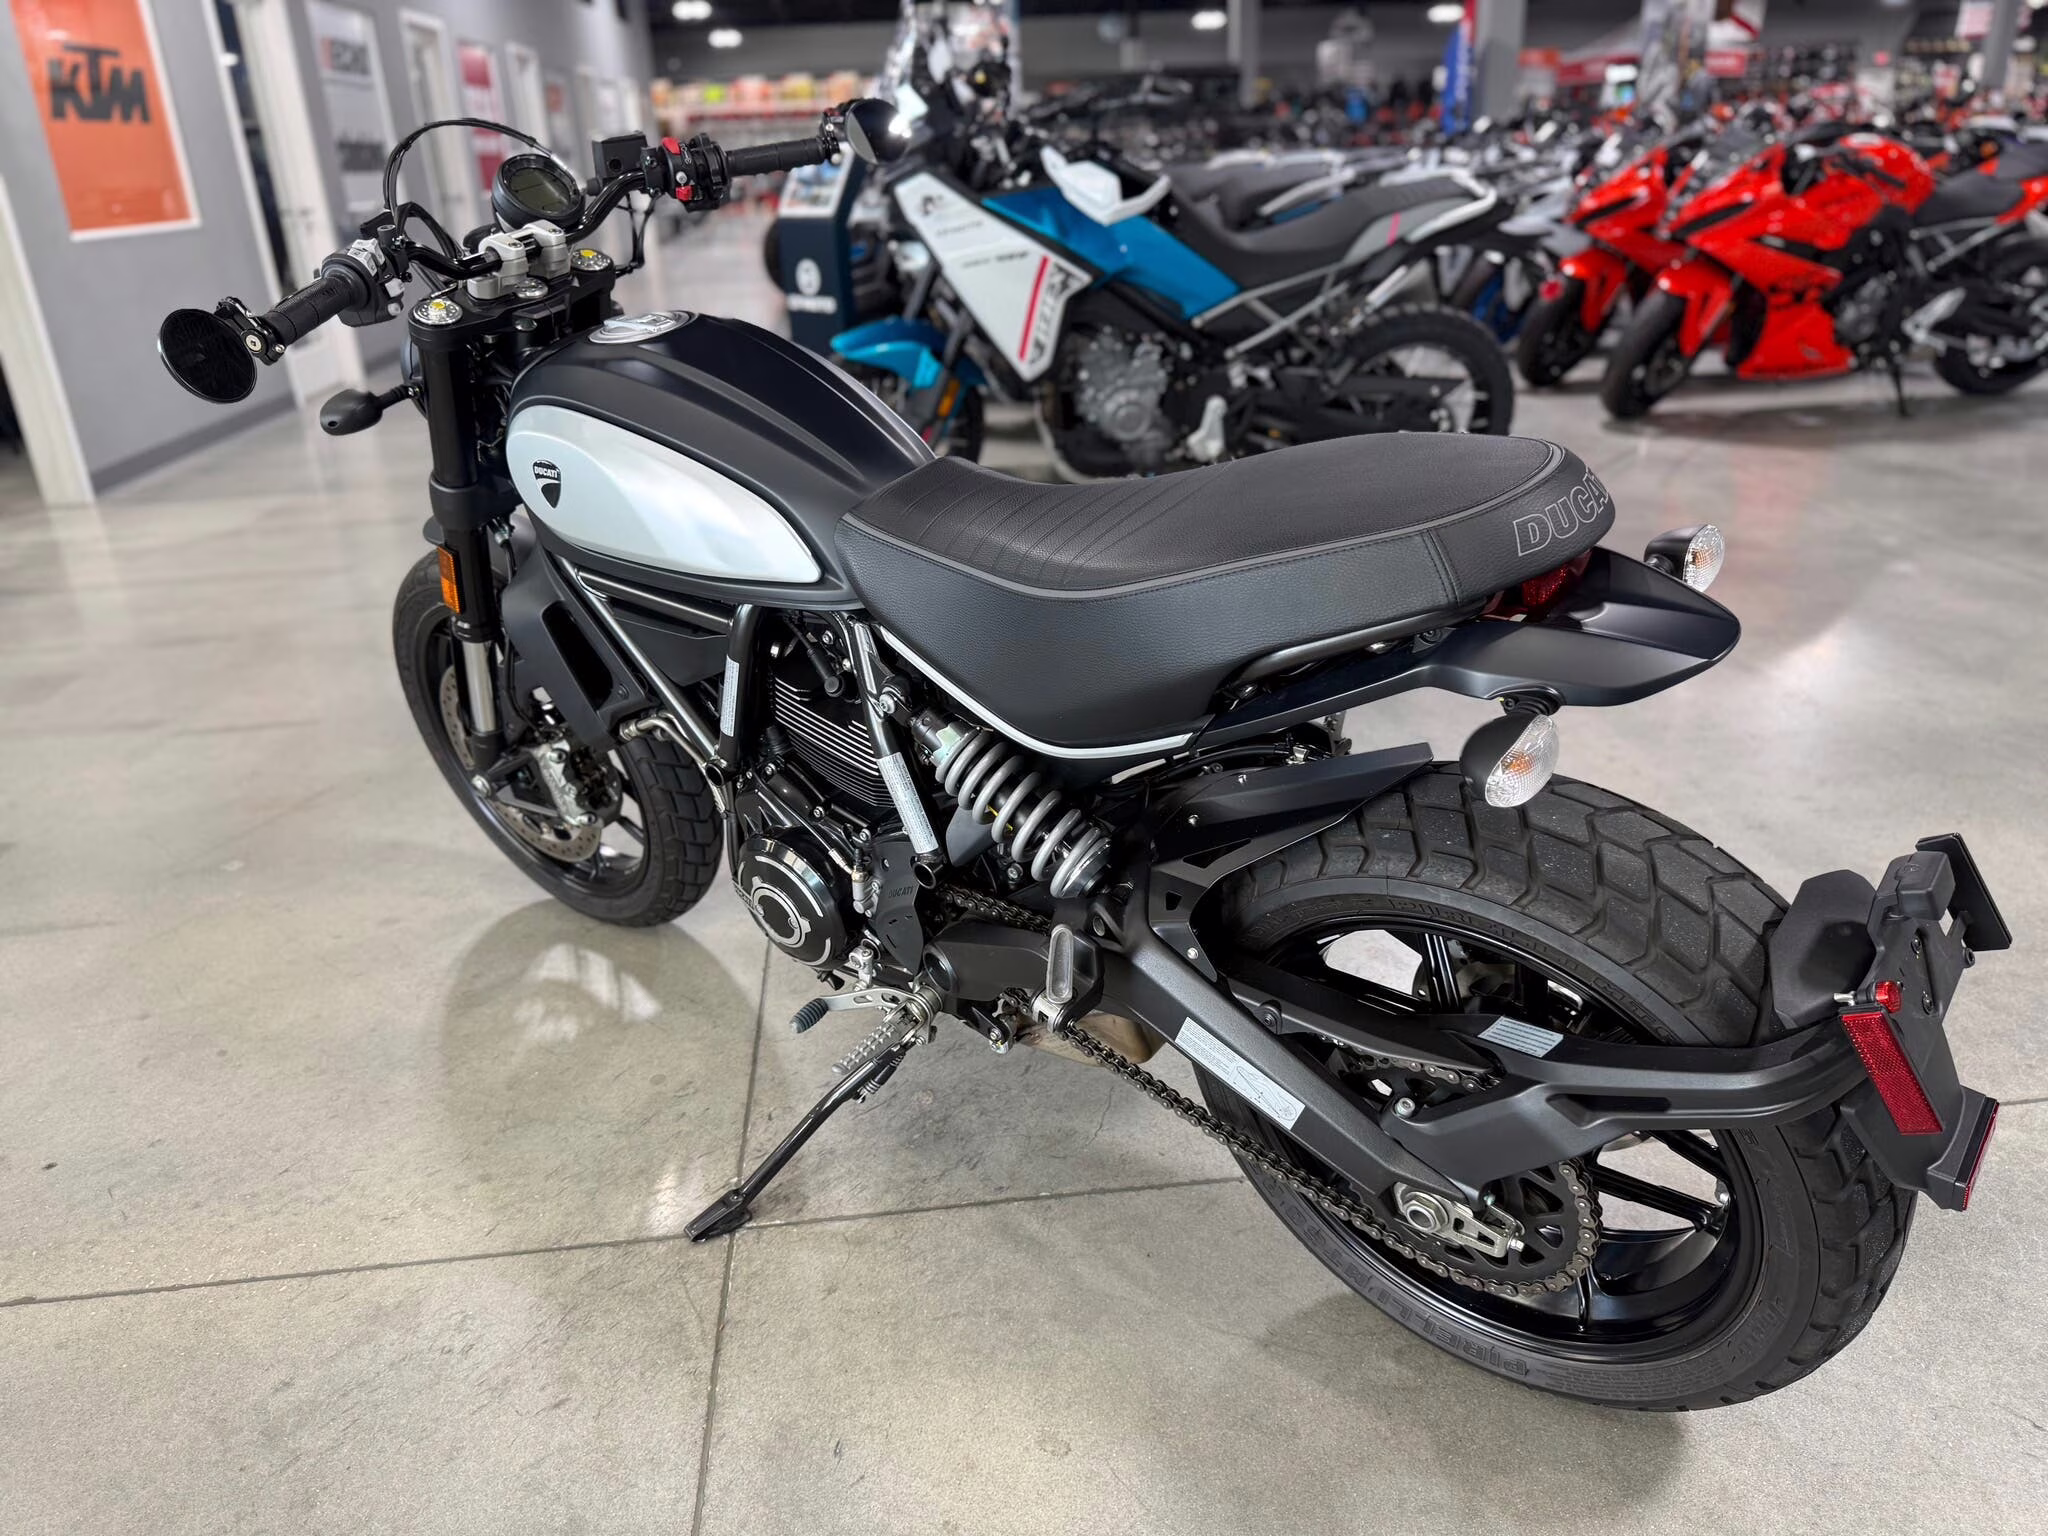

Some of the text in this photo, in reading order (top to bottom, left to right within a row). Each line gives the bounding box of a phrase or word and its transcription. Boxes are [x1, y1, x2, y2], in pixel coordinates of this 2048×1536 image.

[47, 42, 151, 124] KTM
[534, 466, 558, 479] DUCATI
[888, 885, 914, 898] DUCATI
[1377, 1290, 1529, 1376] PIRELLI
